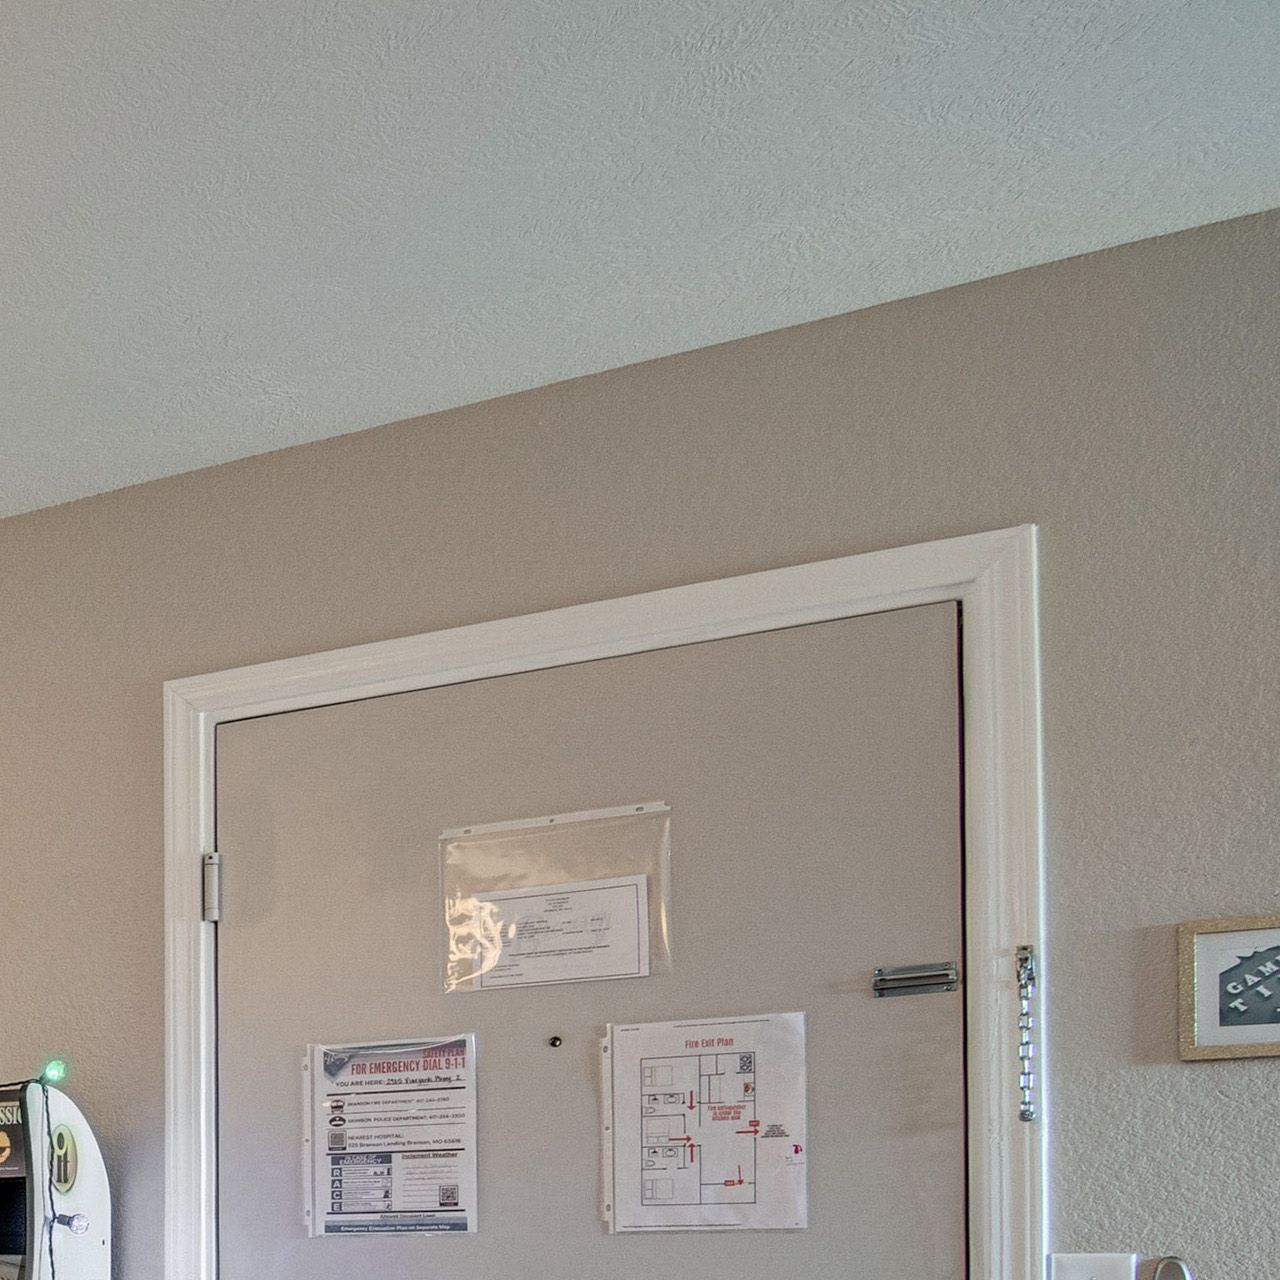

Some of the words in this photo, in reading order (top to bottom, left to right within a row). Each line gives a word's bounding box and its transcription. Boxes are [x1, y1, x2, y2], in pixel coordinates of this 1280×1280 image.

[1226, 955, 1280, 994] GAM
[685, 1039, 699, 1049] Fire
[701, 1038, 715, 1048] Exit
[717, 1038, 734, 1047] Plan
[352, 1063, 367, 1075] FOR
[370, 1059, 420, 1074] EMERGENCY
[423, 1057, 443, 1070] DIAL
[445, 1057, 465, 1069] 9-1-1
[333, 1169, 340, 1177] R
[333, 1180, 341, 1189] A
[333, 1191, 340, 1200] C
[333, 1202, 340, 1211] E
